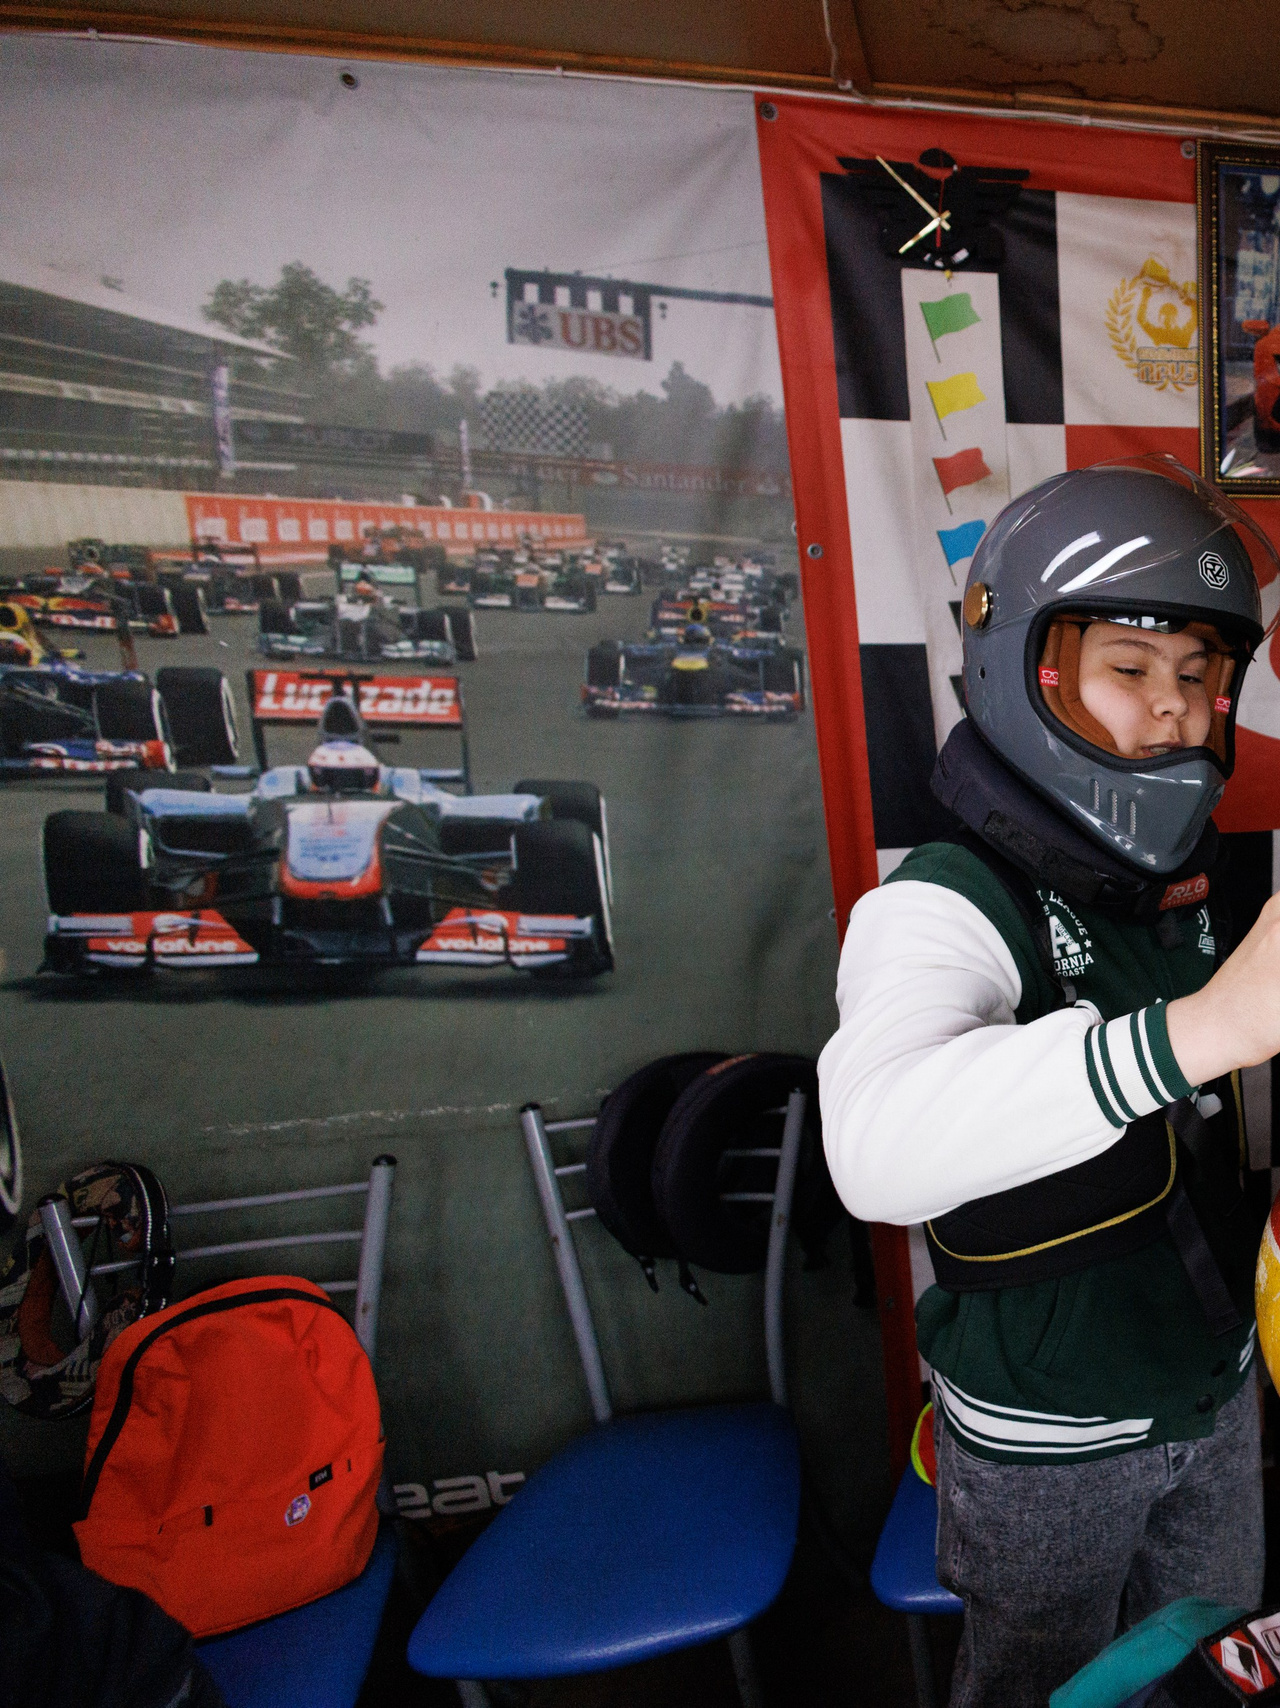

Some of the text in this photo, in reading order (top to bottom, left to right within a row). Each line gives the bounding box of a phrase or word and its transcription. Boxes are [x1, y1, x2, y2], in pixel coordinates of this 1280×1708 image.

[558, 311, 642, 354] UBS
[258, 673, 456, 716] Luczade
[1167, 878, 1206, 901] RLG
